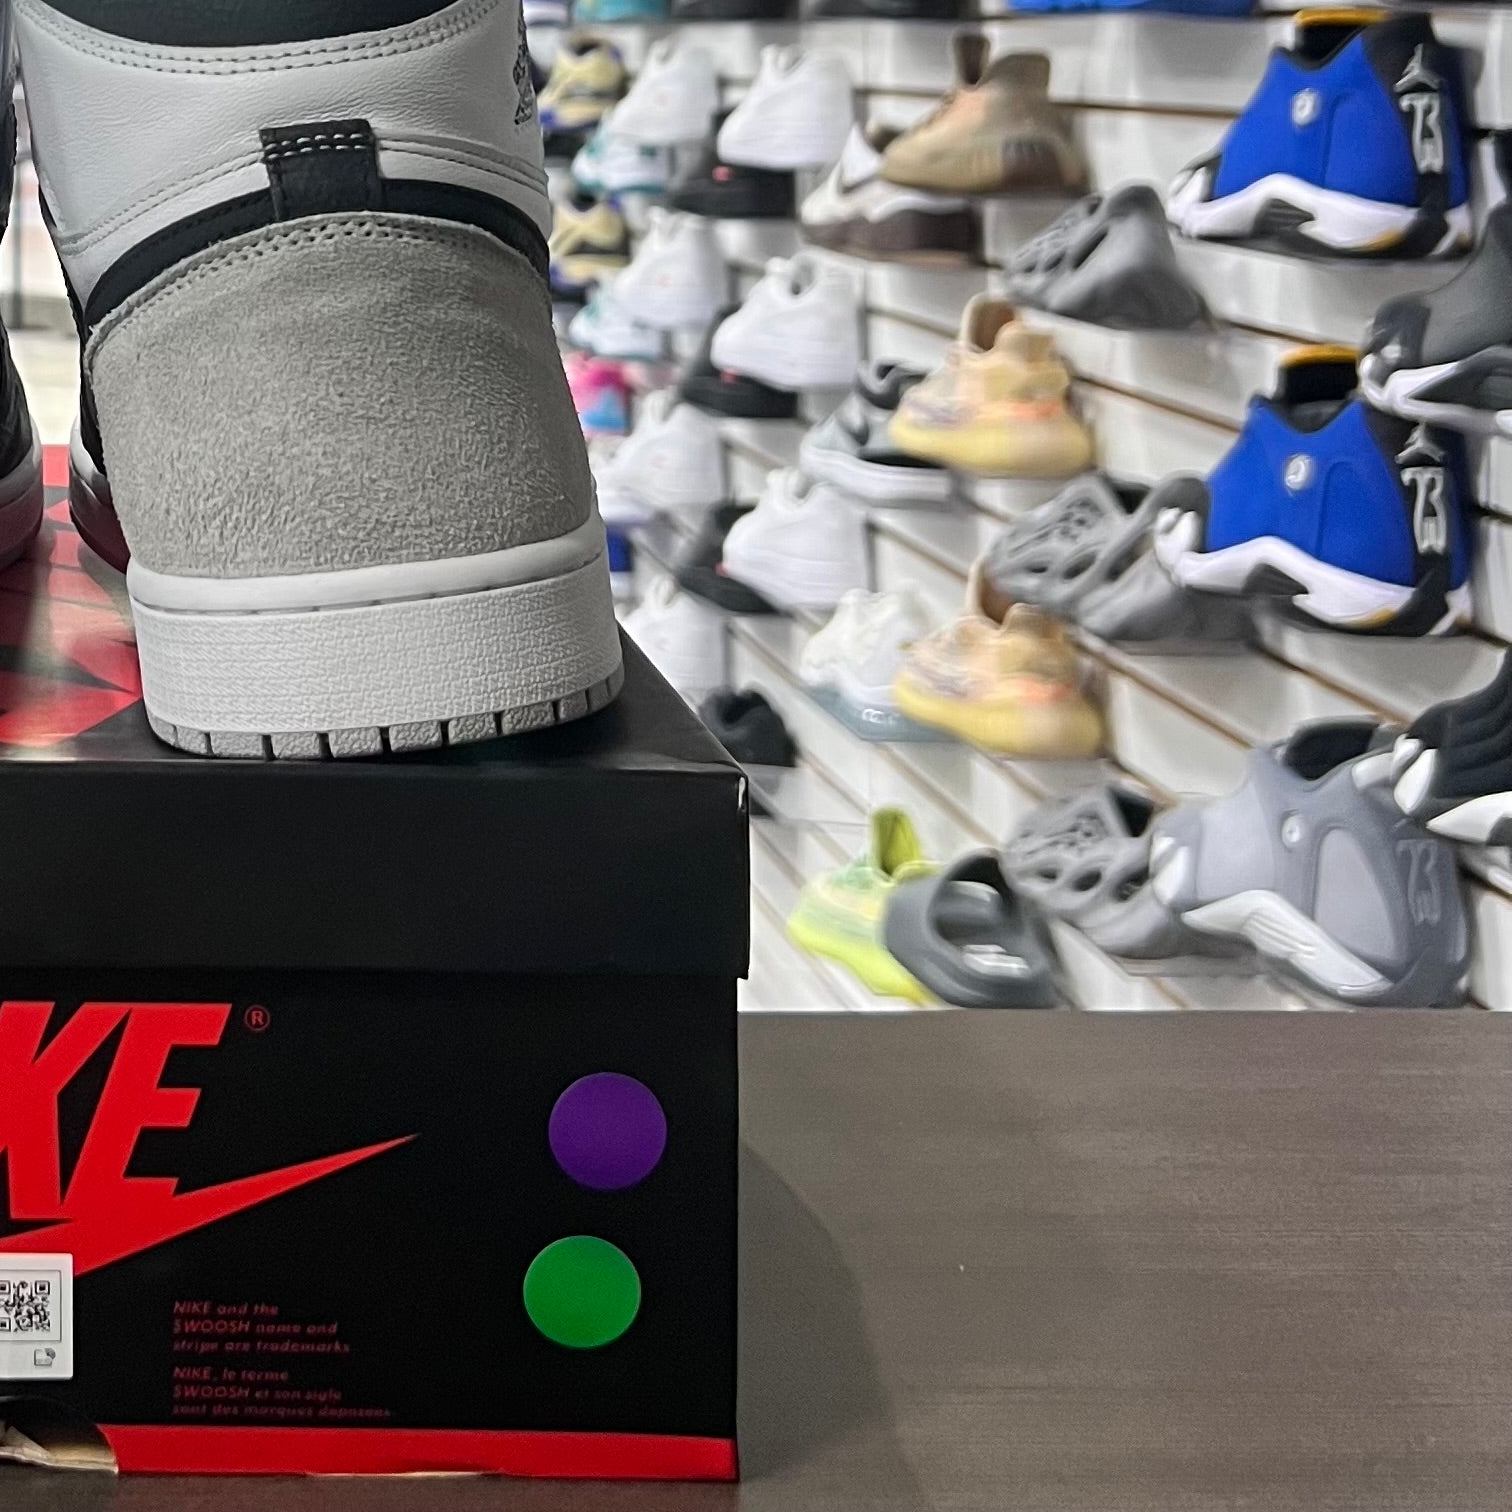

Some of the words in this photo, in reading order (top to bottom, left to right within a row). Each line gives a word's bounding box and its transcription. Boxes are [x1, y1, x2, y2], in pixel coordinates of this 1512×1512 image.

[173, 1300, 212, 1314] NIKE
[217, 1302, 248, 1315] and
[253, 1302, 279, 1315] the
[173, 1319, 250, 1334] SWOOSH
[256, 1323, 301, 1334] name
[306, 1321, 338, 1335] and
[173, 1340, 219, 1354] stripe
[224, 1342, 250, 1352] are
[256, 1339, 350, 1353] trademarks
[222, 1368, 236, 1380] le
[241, 1369, 289, 1381] terme
[173, 1385, 250, 1399] SWOOSH
